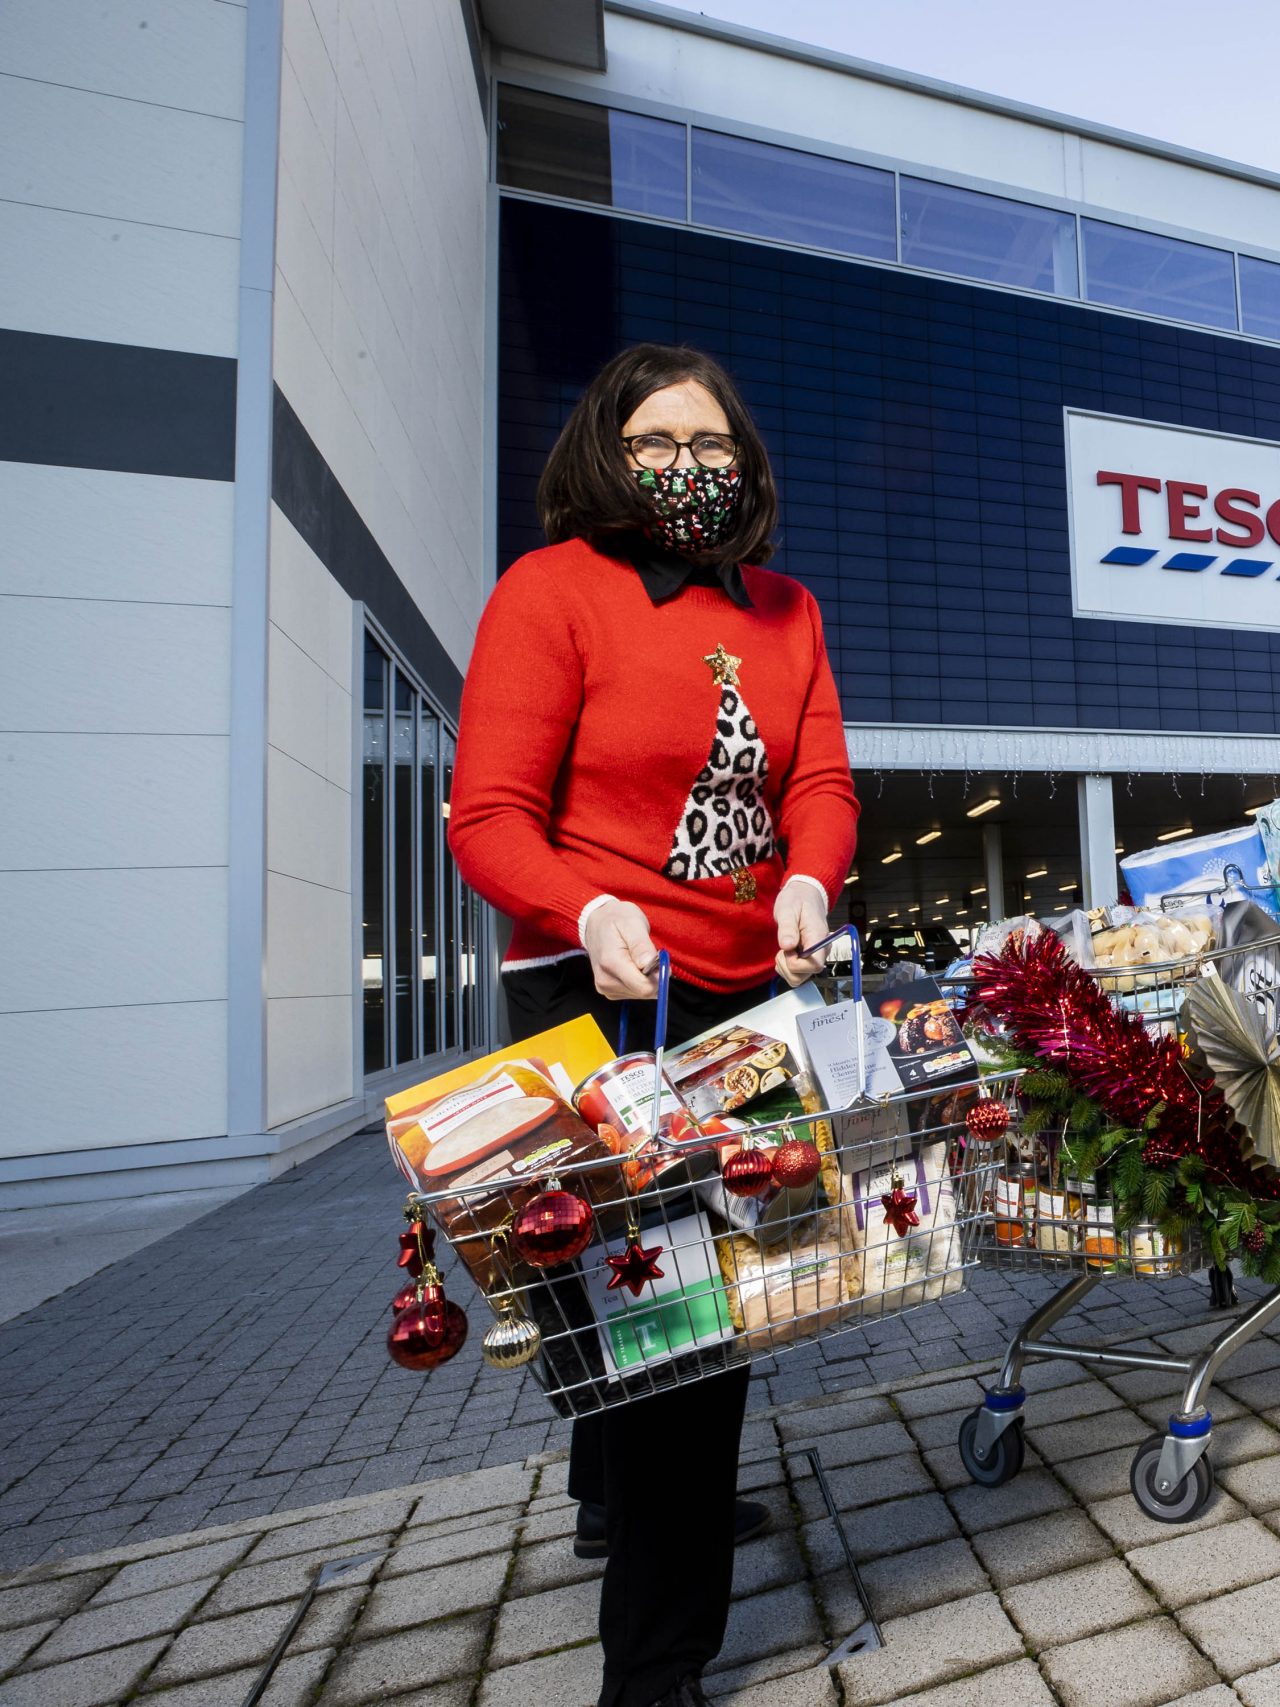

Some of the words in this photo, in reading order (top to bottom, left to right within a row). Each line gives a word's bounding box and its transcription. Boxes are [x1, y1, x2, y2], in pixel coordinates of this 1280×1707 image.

[1161, 899, 1184, 908] ESCO
[810, 1011, 846, 1031] finest
[620, 1070, 645, 1083] TESCO
[602, 1294, 618, 1305] Tea
[635, 1321, 657, 1351] T
